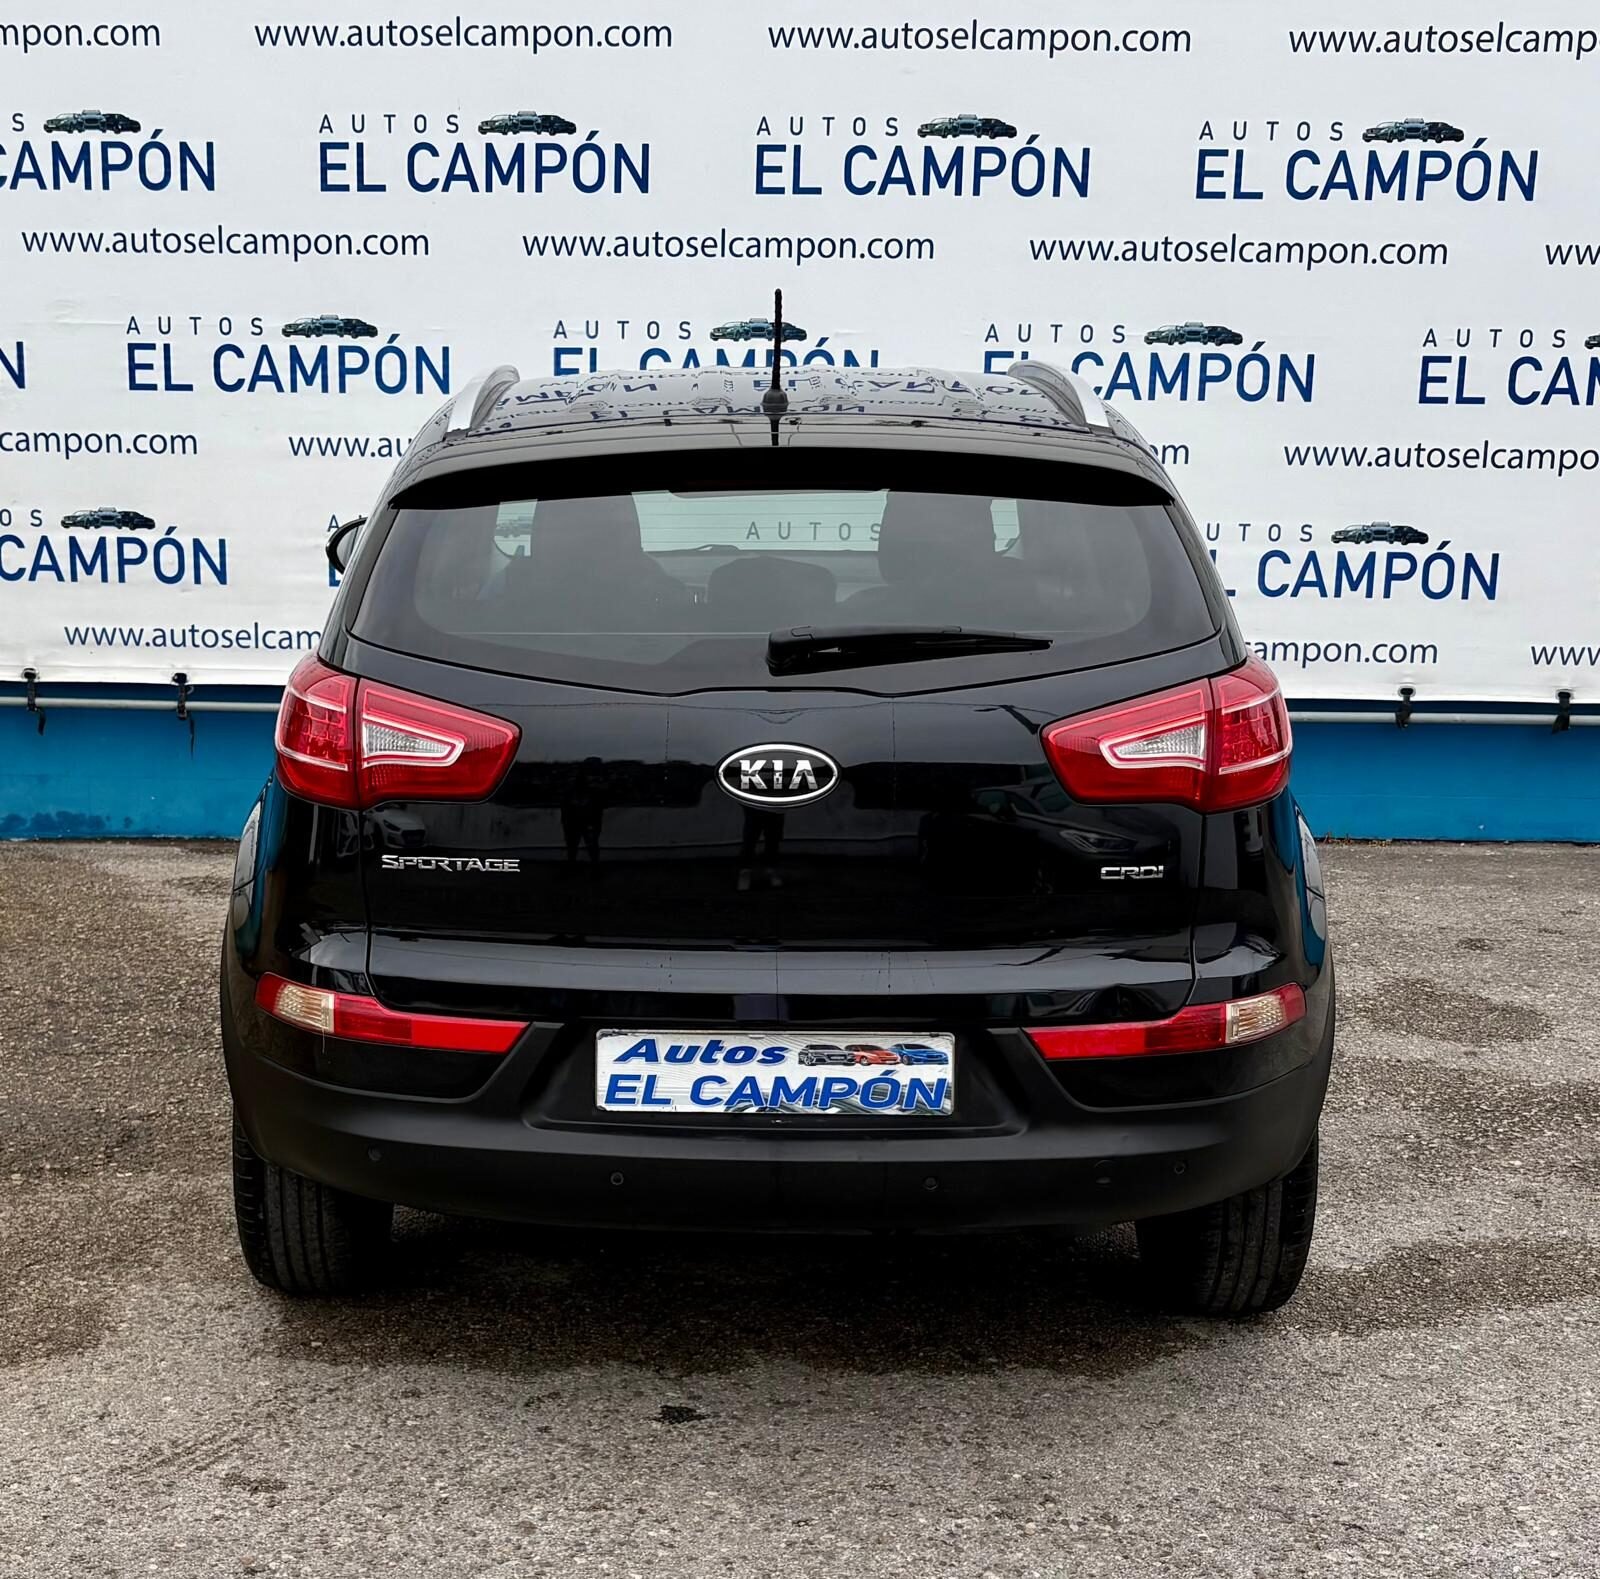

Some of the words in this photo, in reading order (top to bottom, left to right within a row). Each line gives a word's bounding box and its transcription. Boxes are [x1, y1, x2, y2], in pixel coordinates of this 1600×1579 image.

[254, 16, 672, 55] www.autoselcampon.com
[767, 19, 1191, 58] www.autoselcampon.com
[318, 114, 459, 134] AUTOS
[756, 116, 899, 137] AUTOS
[1199, 121, 1343, 141] AUTOS
[0, 129, 215, 192] AMPÓN
[319, 142, 387, 193] EL
[407, 131, 650, 193] CAMPÓN
[755, 145, 823, 195] EL
[844, 135, 1091, 198] CAMPÓN
[1196, 149, 1264, 200] EL
[1285, 138, 1539, 202] CAMPÓN
[22, 225, 429, 262] www.autoselcampon.com
[523, 228, 934, 266] www.autoselcampon.com
[1029, 233, 1448, 271] www.autoselcampon.com
[126, 316, 263, 336] AUTOS
[554, 320, 691, 340] AUTOS
[985, 323, 1126, 343] AUTOS
[1423, 328, 1566, 349] AUTOS
[127, 343, 194, 391] EL
[213, 333, 450, 395] CAMPÓN
[1418, 355, 1486, 405] EL
[746, 521, 881, 542] AUTOS
[1206, 523, 1313, 543] UTOS
[0, 527, 228, 586] CAMPÓN
[1257, 541, 1500, 601] CAMPÓN
[739, 759, 819, 790] KIA
[381, 854, 521, 873] SPORTAGE
[612, 1037, 790, 1066] Autos
[603, 1073, 673, 1107] EL
[689, 1069, 949, 1110] CAMPÓN
